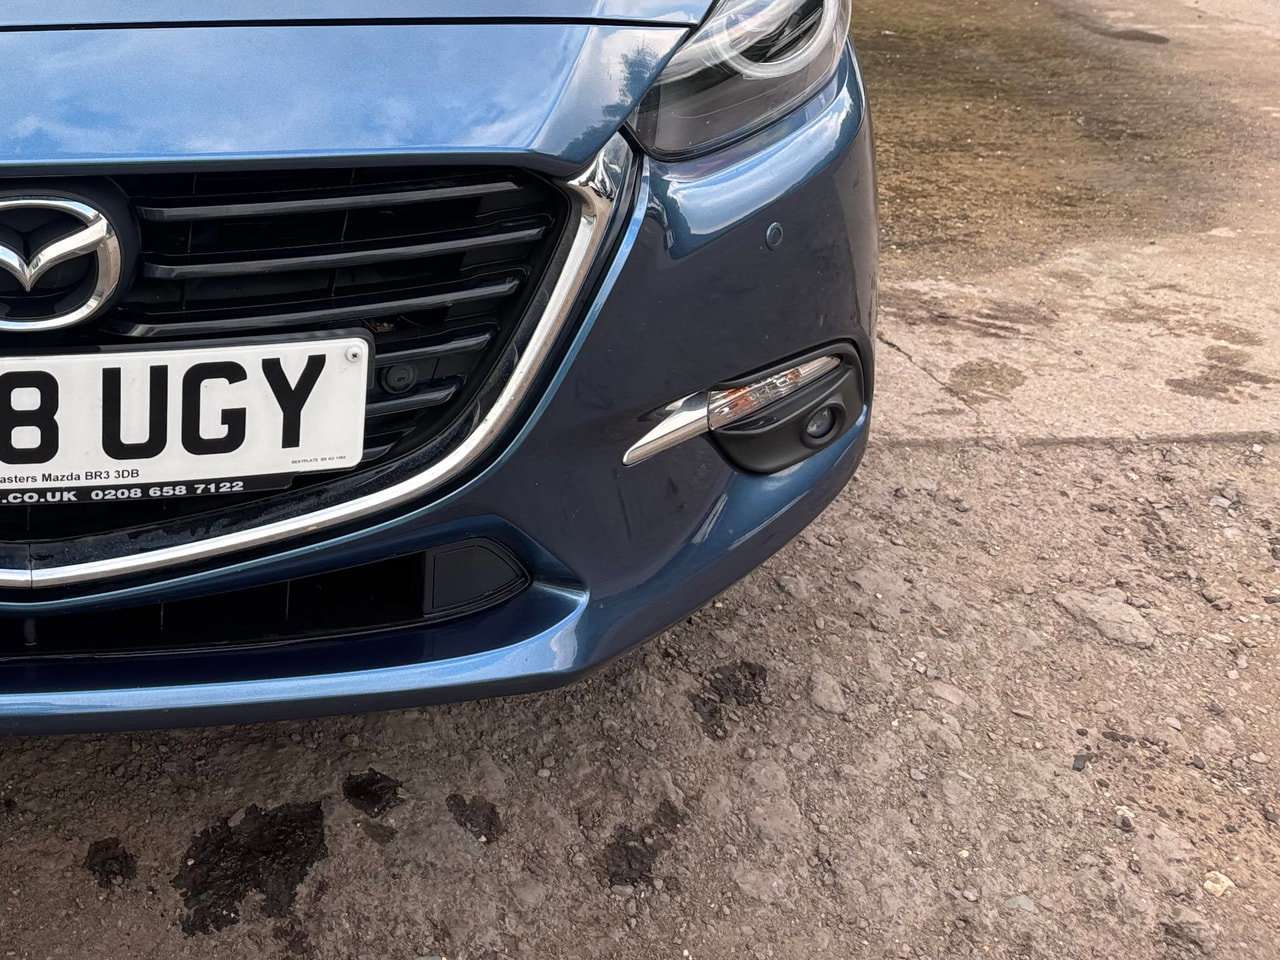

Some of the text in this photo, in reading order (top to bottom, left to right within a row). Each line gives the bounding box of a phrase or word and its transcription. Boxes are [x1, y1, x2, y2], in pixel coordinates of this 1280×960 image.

[101, 353, 327, 461] UGY
[41, 472, 81, 483] Mazda
[84, 470, 111, 481] BR3
[114, 468, 140, 479] 3DB
[90, 488, 143, 501] 0208
[148, 484, 187, 498] 658
[194, 480, 245, 495] 7122
